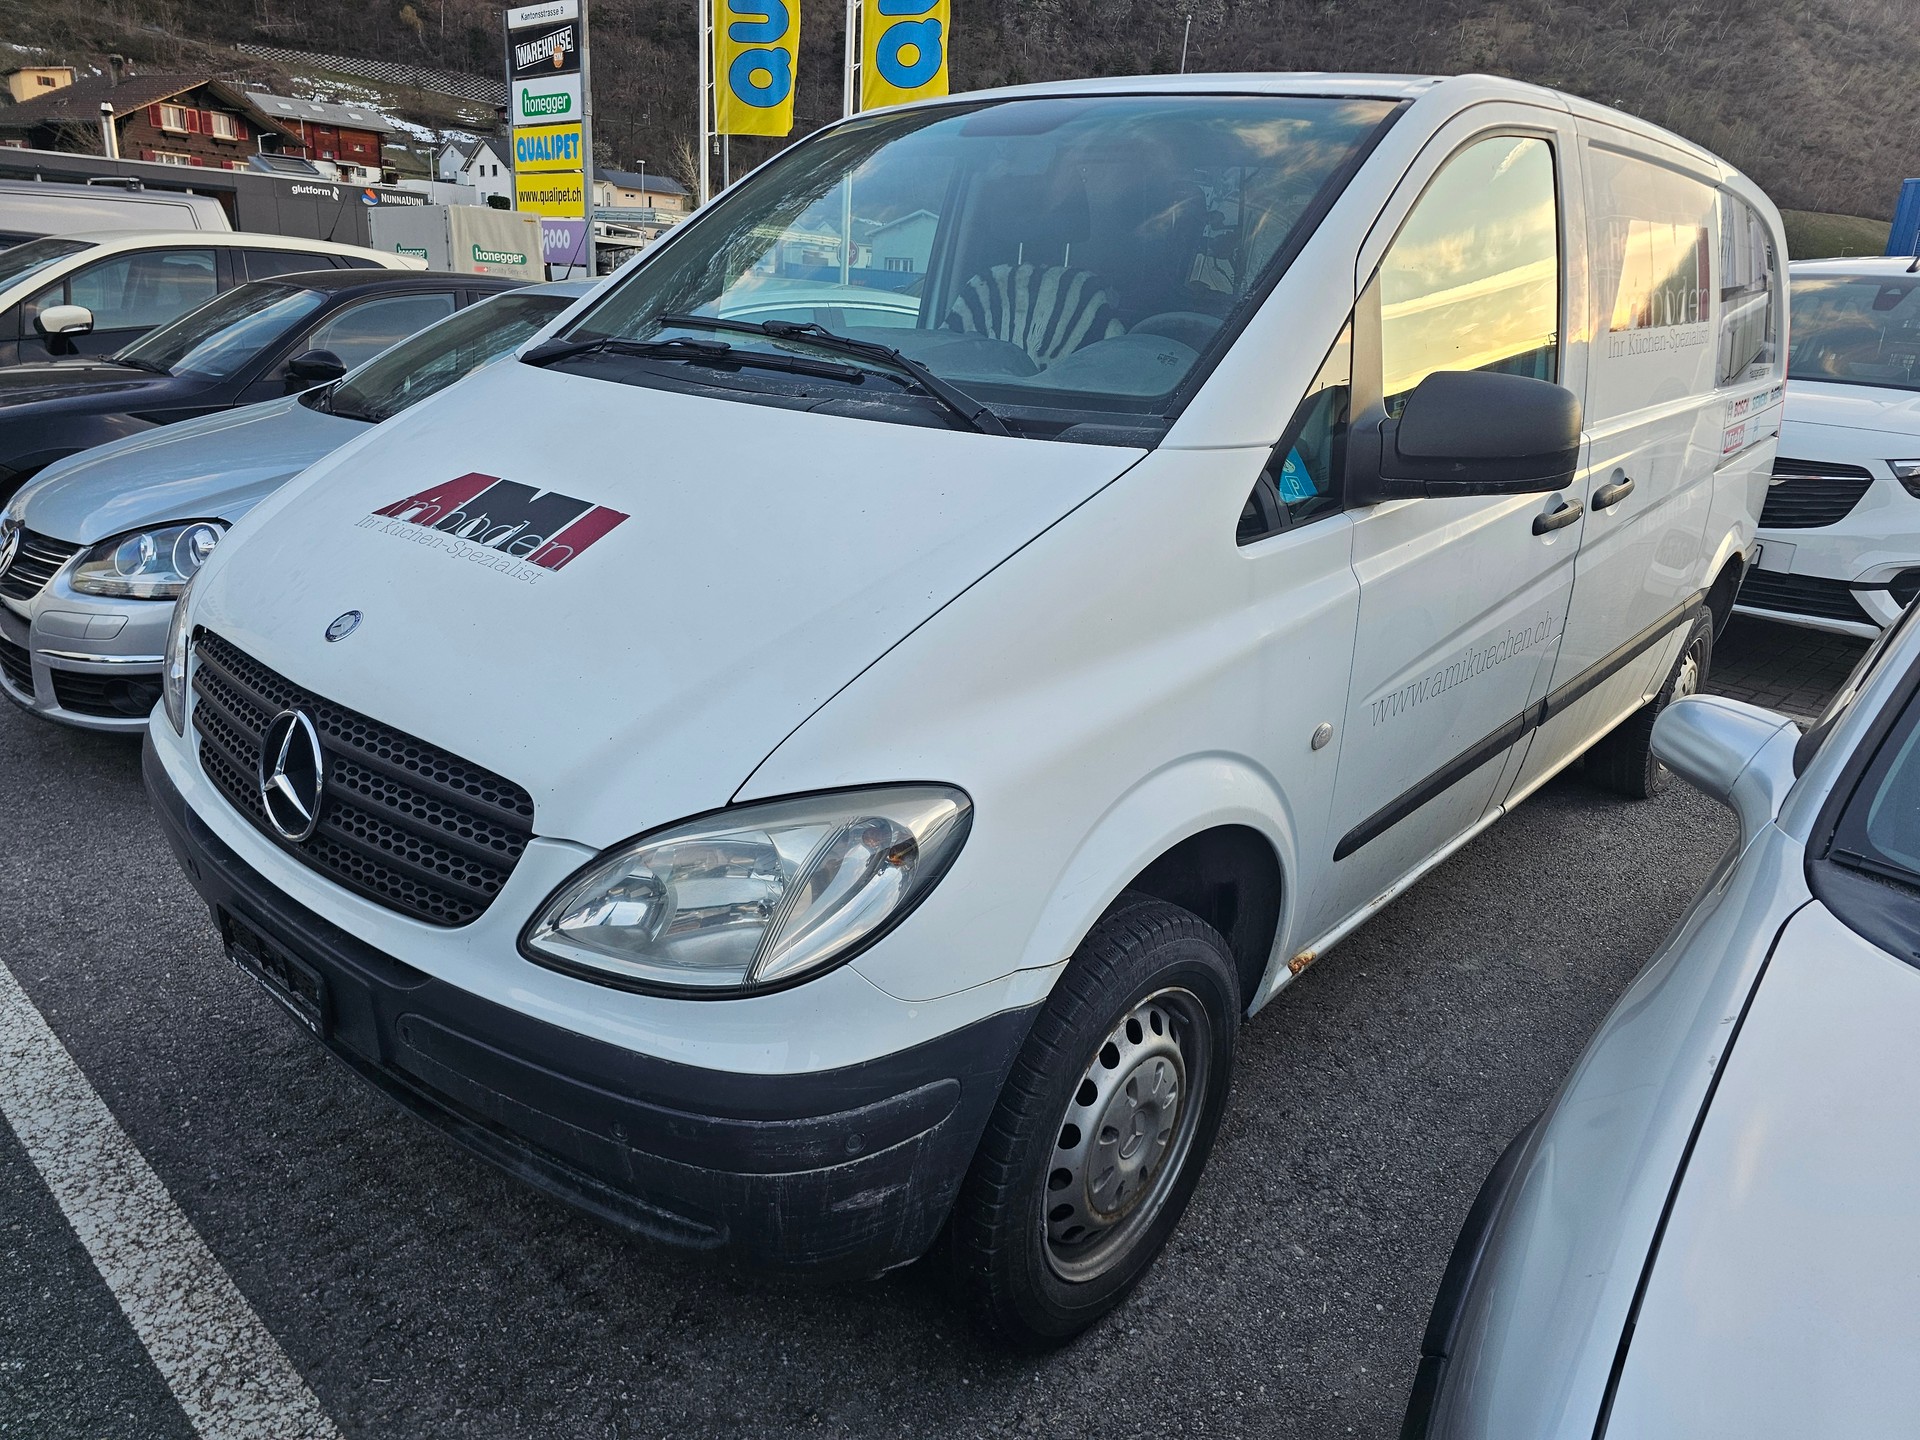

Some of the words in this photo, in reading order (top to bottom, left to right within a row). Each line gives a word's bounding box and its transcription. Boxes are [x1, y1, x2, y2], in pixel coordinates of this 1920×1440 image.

[521, 9, 559, 21] Kantonsstrasse
[560, 5, 564, 15] 9
[517, 29, 572, 67] WAREHOUSE
[524, 94, 568, 114] honegger
[516, 132, 580, 163] QUALIPET
[291, 184, 331, 197] glutform
[518, 186, 582, 206] www.qualipet.ch
[475, 247, 523, 265] honegger
[1608, 335, 1625, 359] Ihr
[1733, 398, 1750, 418] BOSCH
[354, 514, 382, 529] Ihr
[378, 520, 544, 585] Küchen-Spezialist
[1371, 611, 1552, 727] www.amikuechen.ch
